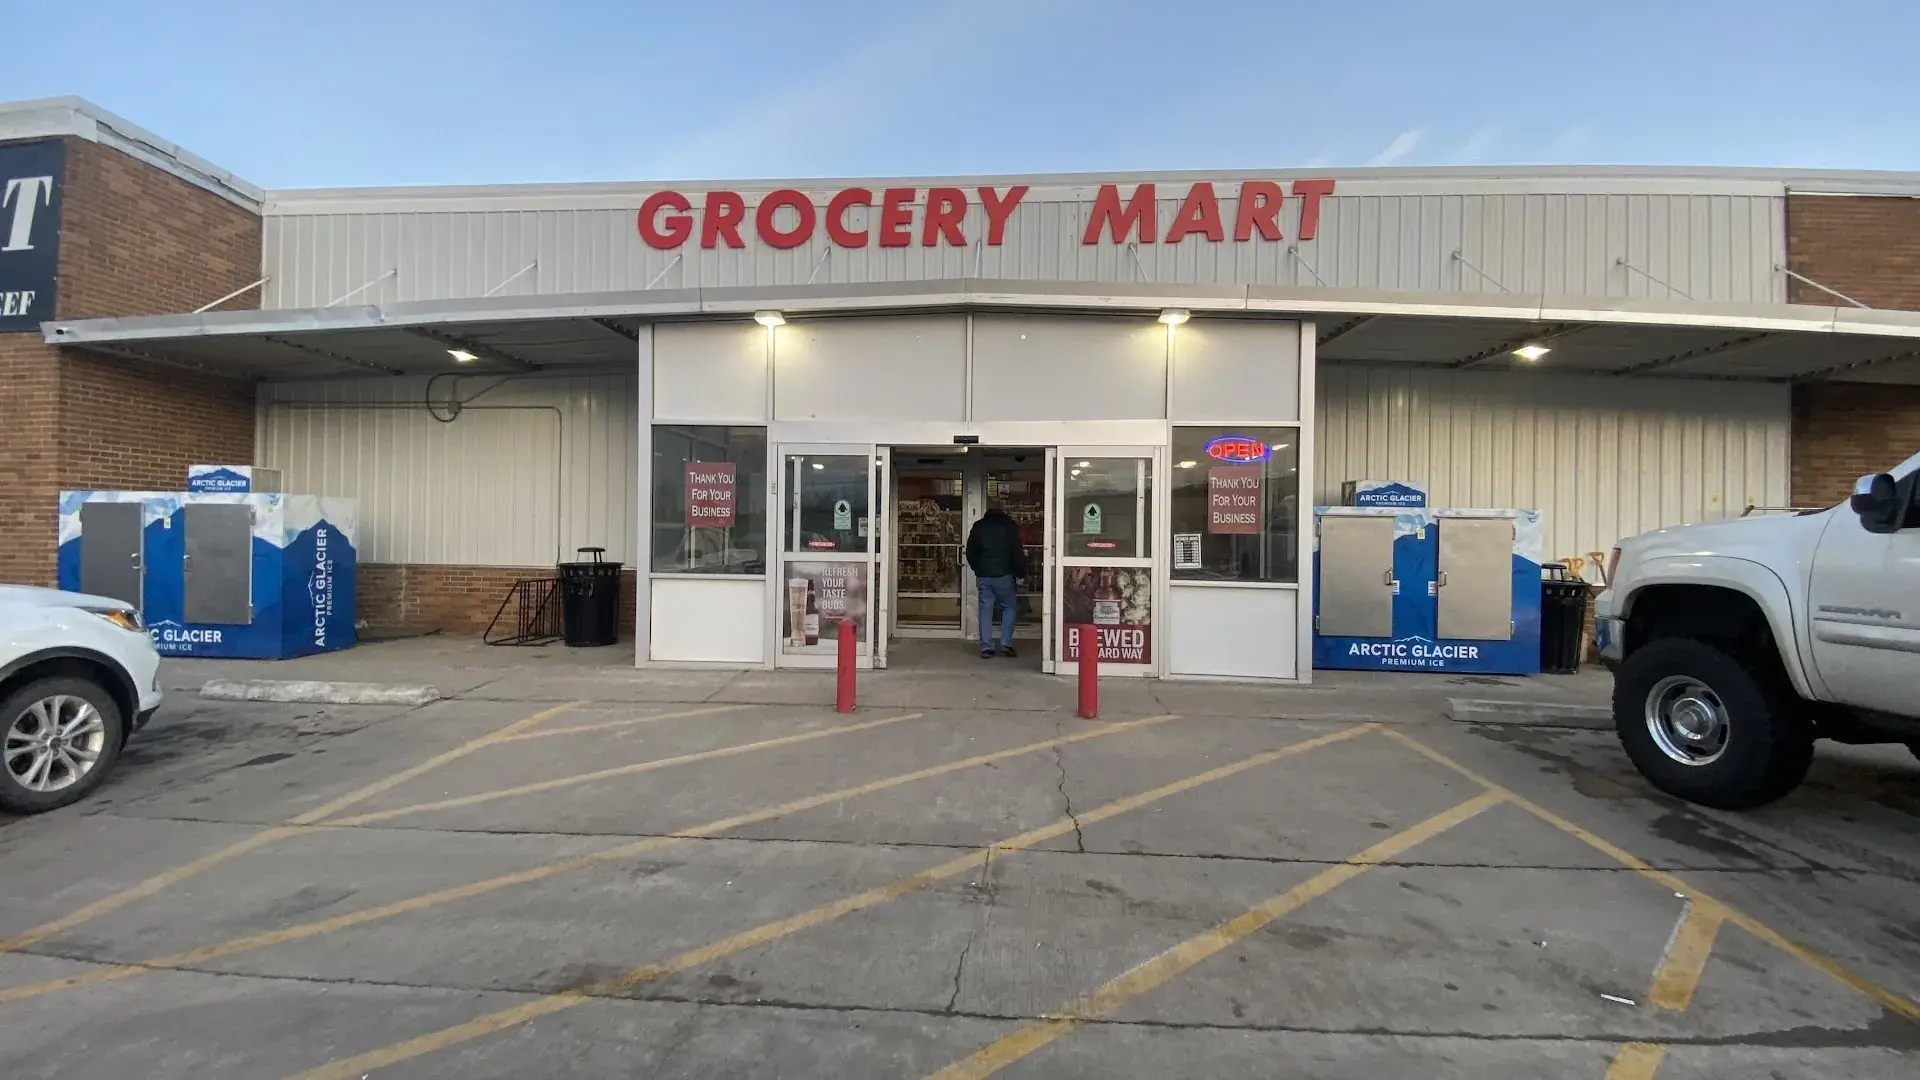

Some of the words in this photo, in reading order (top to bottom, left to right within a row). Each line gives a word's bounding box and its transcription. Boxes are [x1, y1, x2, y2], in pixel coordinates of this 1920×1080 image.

[637, 186, 1030, 249] GROCERY
[1082, 179, 1336, 245] MART
[0, 291, 35, 316] EF
[1208, 442, 1265, 458] OPEN
[192, 479, 216, 487] ARCTIC
[217, 479, 247, 487] GLACIER
[689, 471, 717, 484] THANK
[717, 472, 734, 484] YOU
[1210, 476, 1240, 489] THANK
[1240, 476, 1260, 489] YOU
[691, 488, 708, 500] FOR
[709, 488, 731, 501] YOUR
[1212, 494, 1230, 507] FOR
[1232, 494, 1256, 507] YOUR
[1360, 494, 1388, 502] ARCTIC
[1389, 494, 1422, 502] GLACIER
[691, 504, 731, 518] BUSINESS
[1213, 511, 1256, 524] BUSINESS
[315, 528, 327, 590] GLACIER
[822, 567, 858, 577] REFRESH
[822, 578, 844, 588] YOUR
[821, 588, 846, 599] TASTE
[315, 593, 326, 647] ARCTIC
[163, 628, 222, 643] GLACIER
[1069, 628, 1145, 648] BEWED
[179, 643, 193, 651] ICE
[1097, 647, 1120, 659] ARD
[1121, 648, 1144, 660] WAY
[1348, 643, 1407, 657] ARCTIC
[1411, 644, 1478, 659] GLACIER
[1381, 657, 1426, 666] PREMIUM
[1429, 659, 1445, 667] ICE
